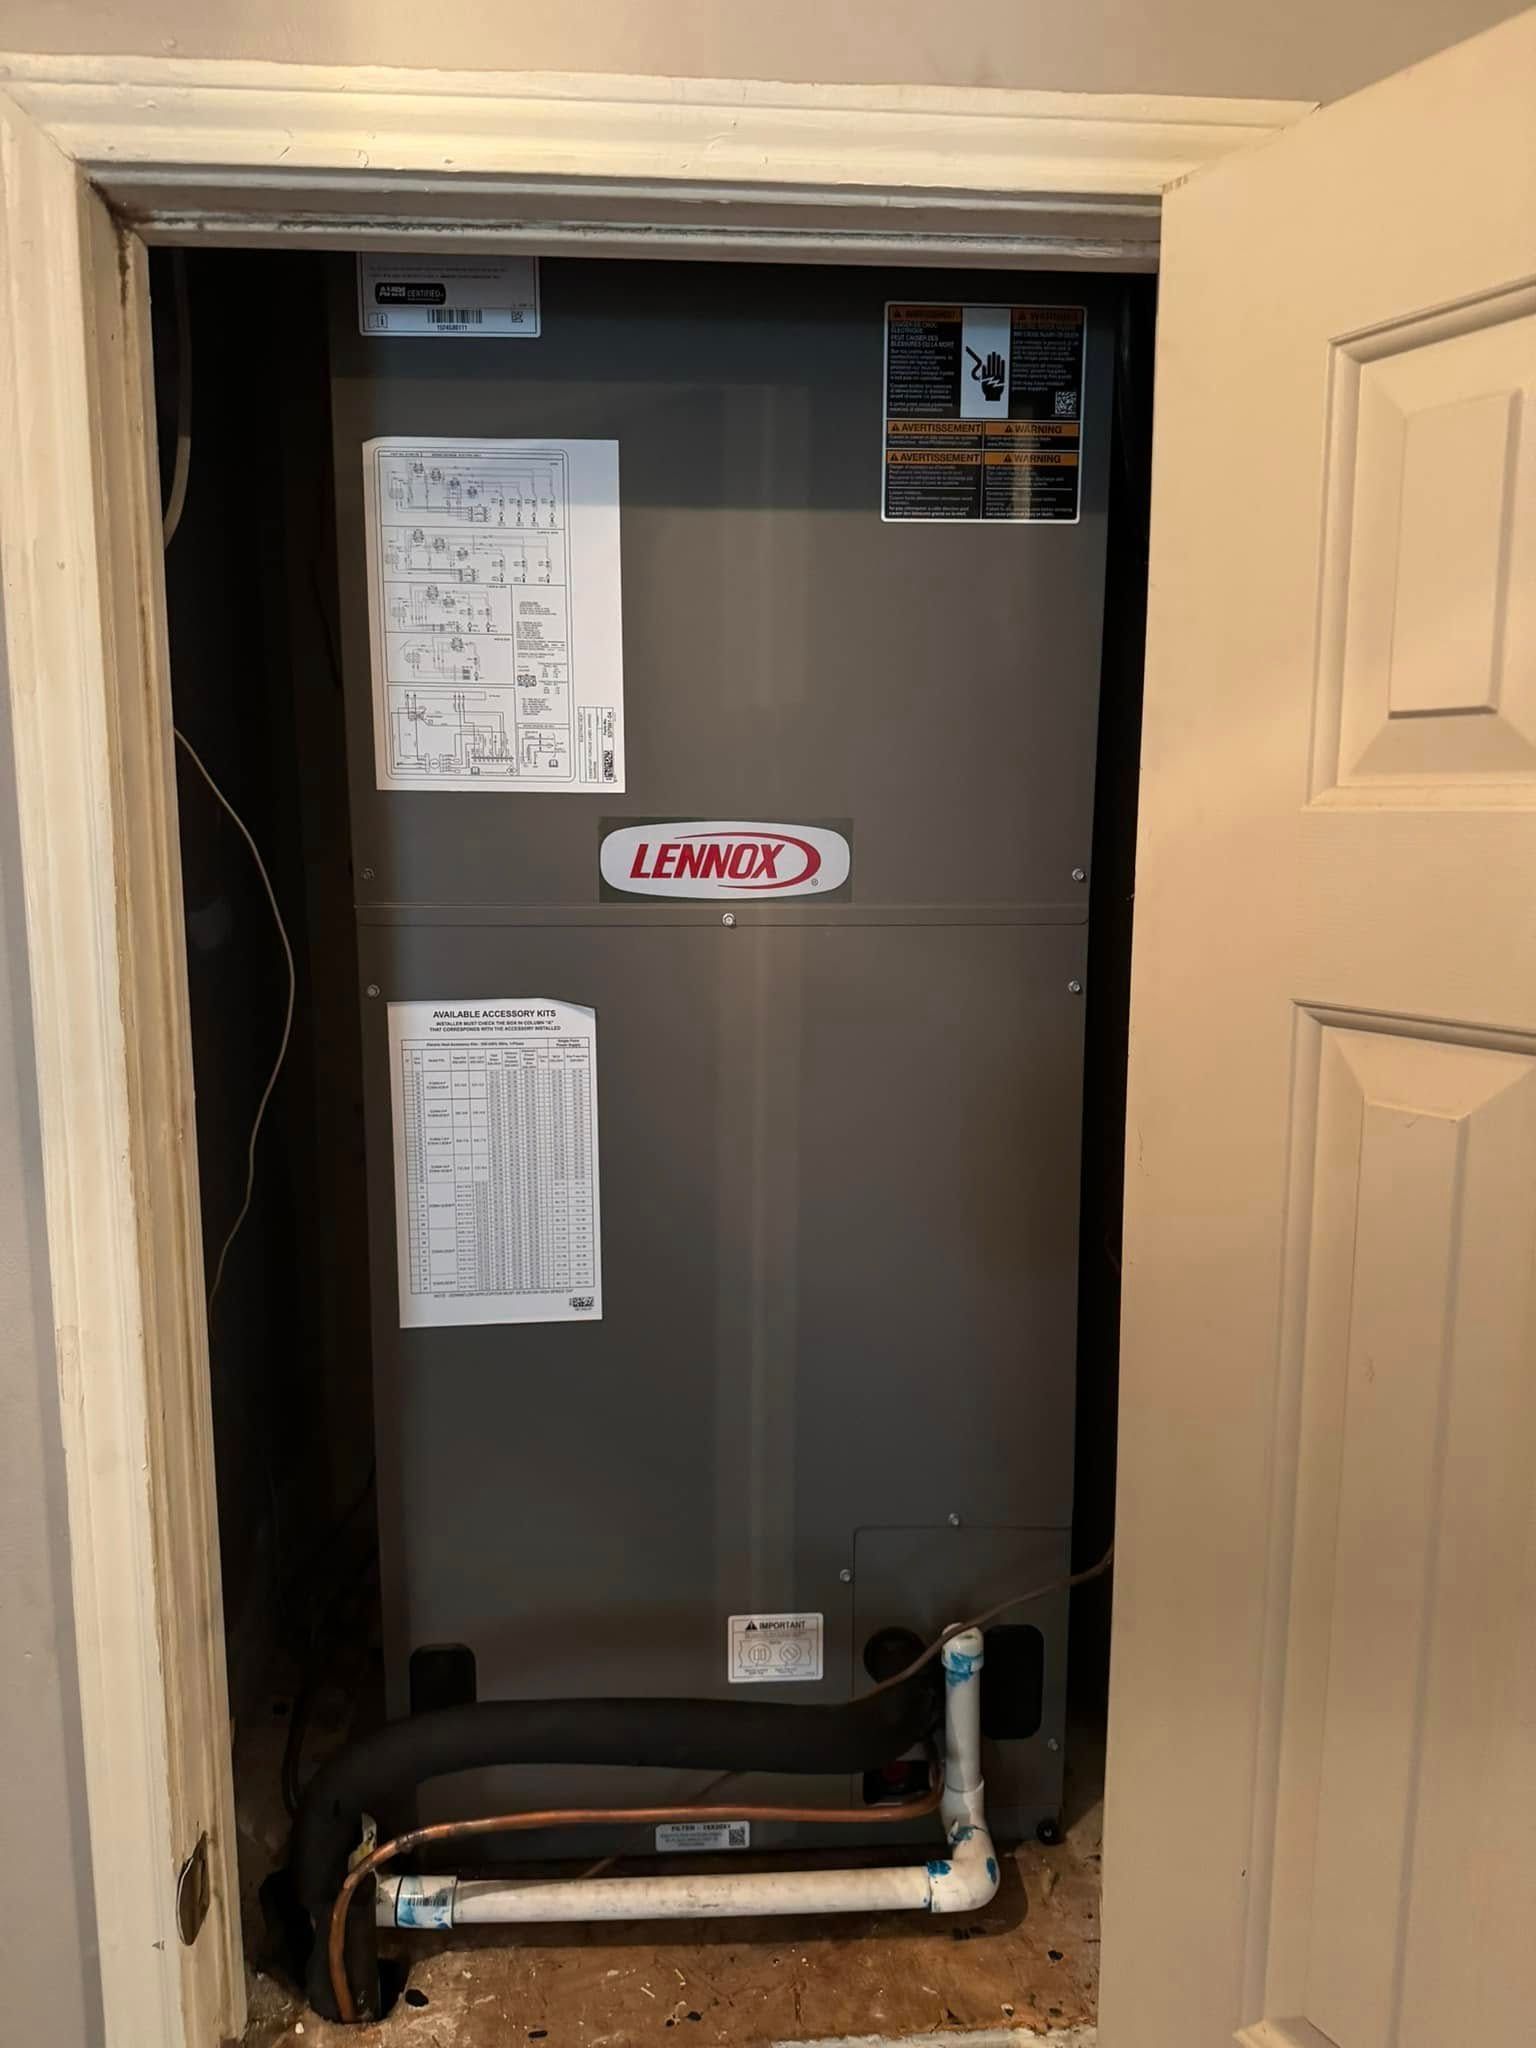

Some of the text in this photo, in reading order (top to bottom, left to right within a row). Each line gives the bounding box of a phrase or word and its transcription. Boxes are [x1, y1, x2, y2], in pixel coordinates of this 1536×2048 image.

[902, 423, 980, 433] AVERTISSEMENT
[1015, 424, 1062, 433] WARNING
[901, 453, 980, 462] AVERTISSEMENT
[1014, 454, 1060, 463] WARNING
[630, 843, 785, 879] LENNOX
[433, 1009, 556, 1018] AVAILABLE ACCESSORY KITS
[760, 1621, 805, 1630] IMPORTANT
